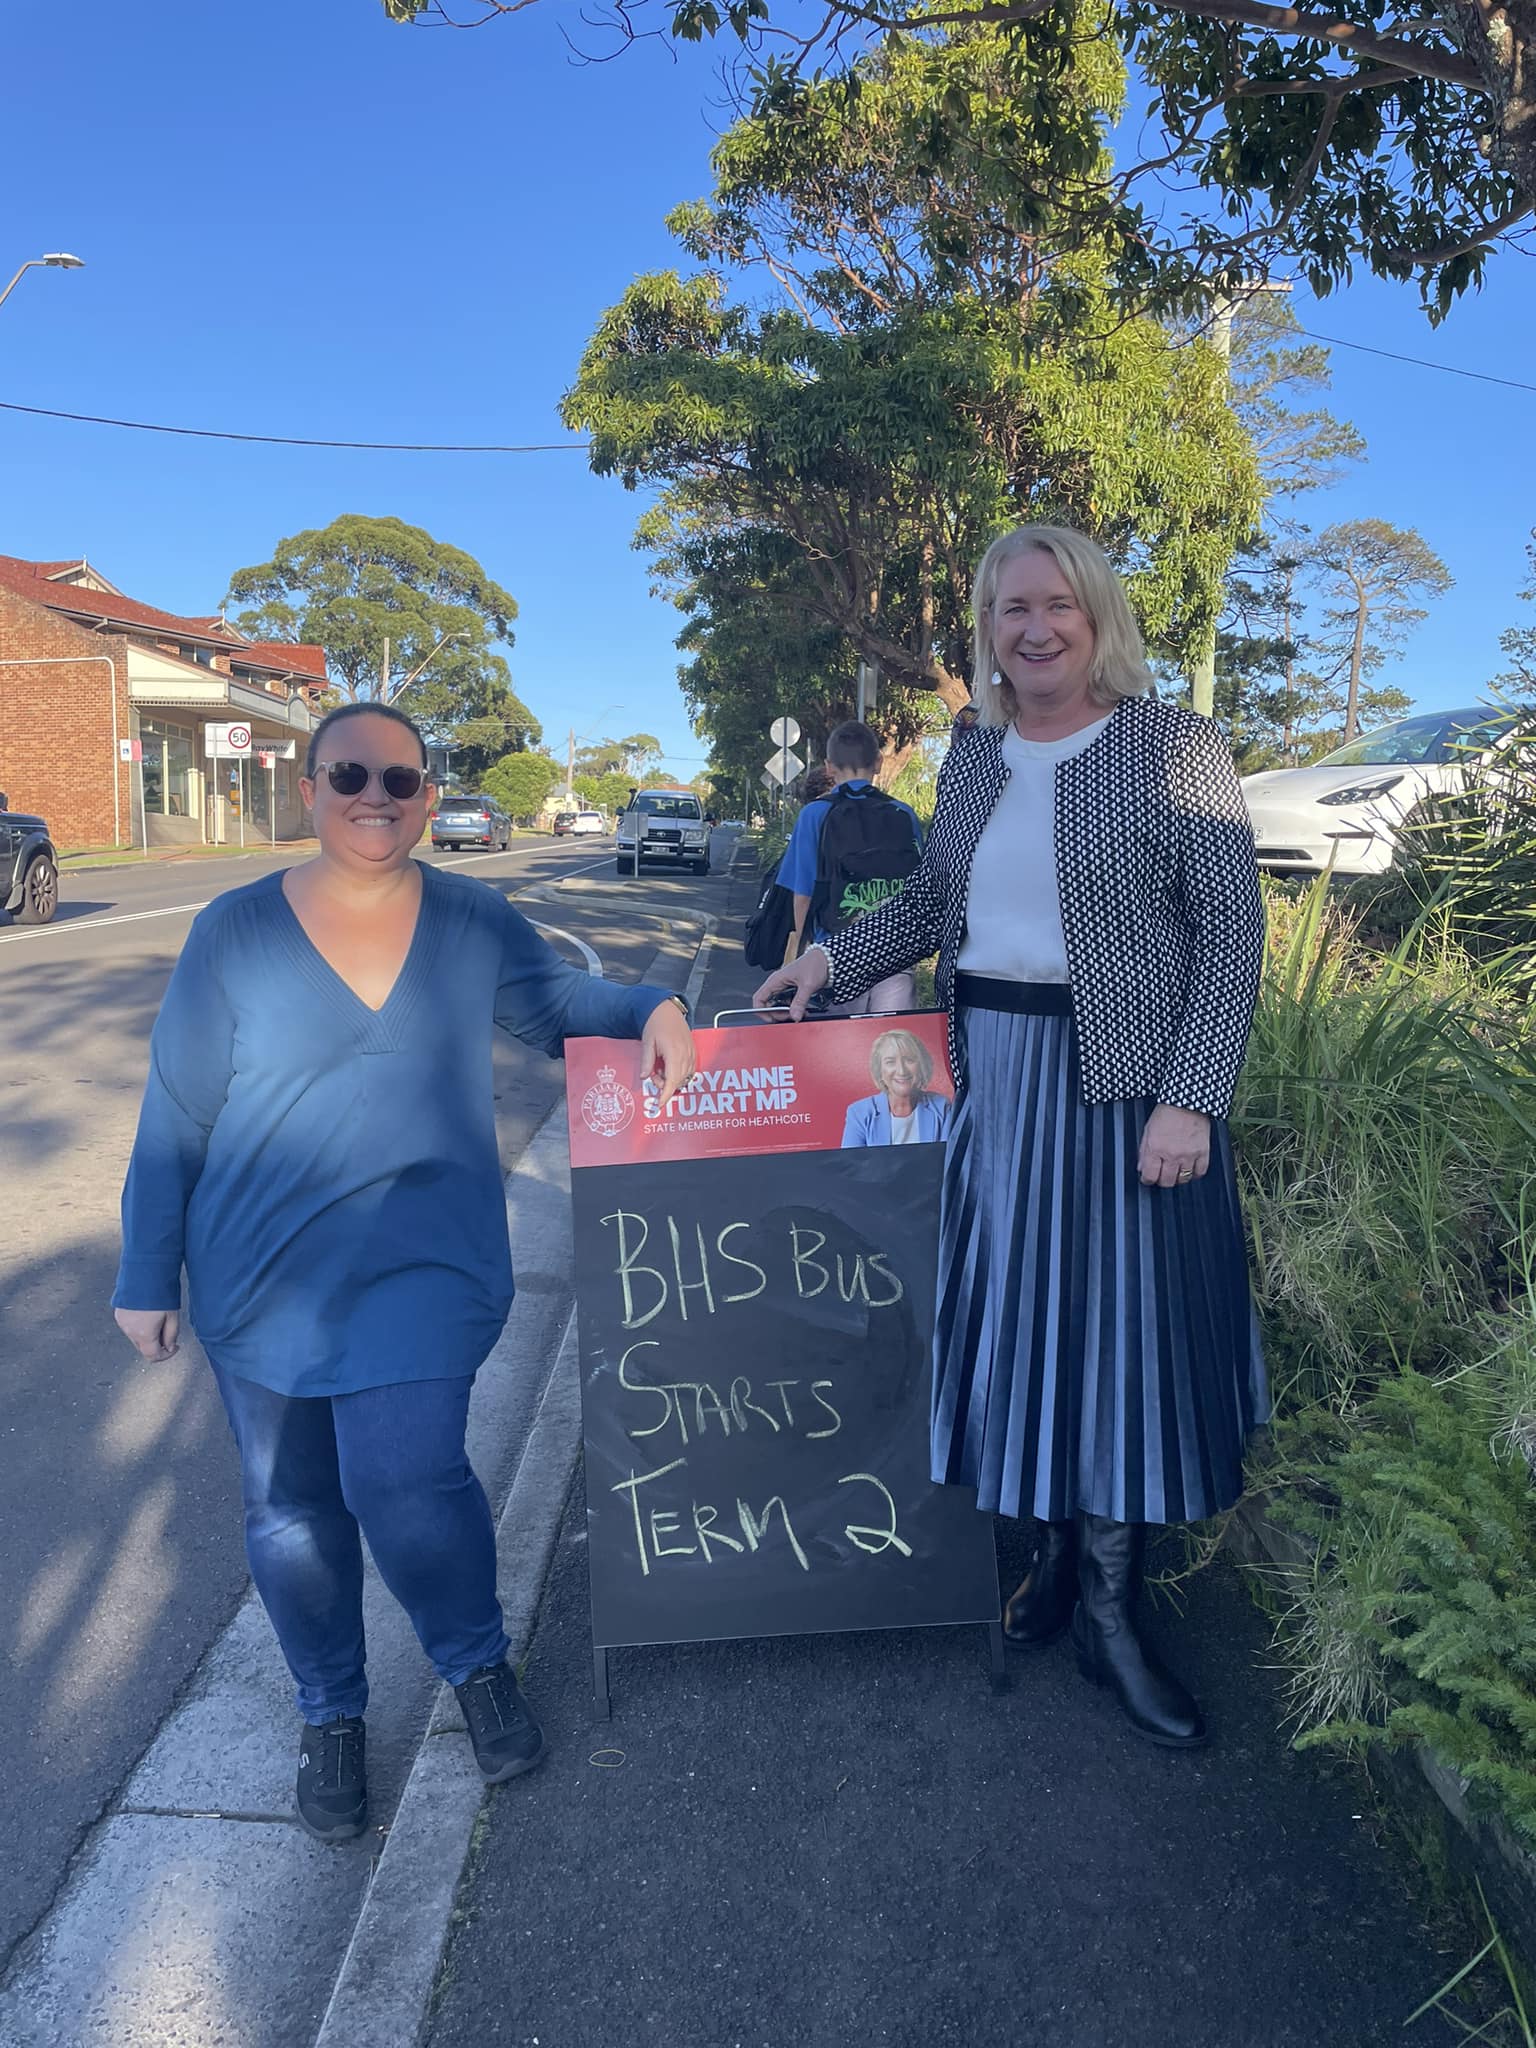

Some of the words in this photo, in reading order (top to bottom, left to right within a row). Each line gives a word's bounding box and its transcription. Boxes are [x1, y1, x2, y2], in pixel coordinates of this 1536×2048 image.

[232, 732, 247, 743] 50
[841, 878, 888, 905] SANTA
[643, 1066, 795, 1097] MRYANNE
[643, 1091, 752, 1119] STUART
[756, 1088, 798, 1111] MP
[643, 1123, 675, 1134] STATE
[678, 1119, 723, 1132] MEMBER
[725, 1117, 746, 1129] FOR
[749, 1113, 812, 1127] HEATHCOTE
[600, 1209, 767, 1329] BHS
[838, 1472, 913, 1557] 2
